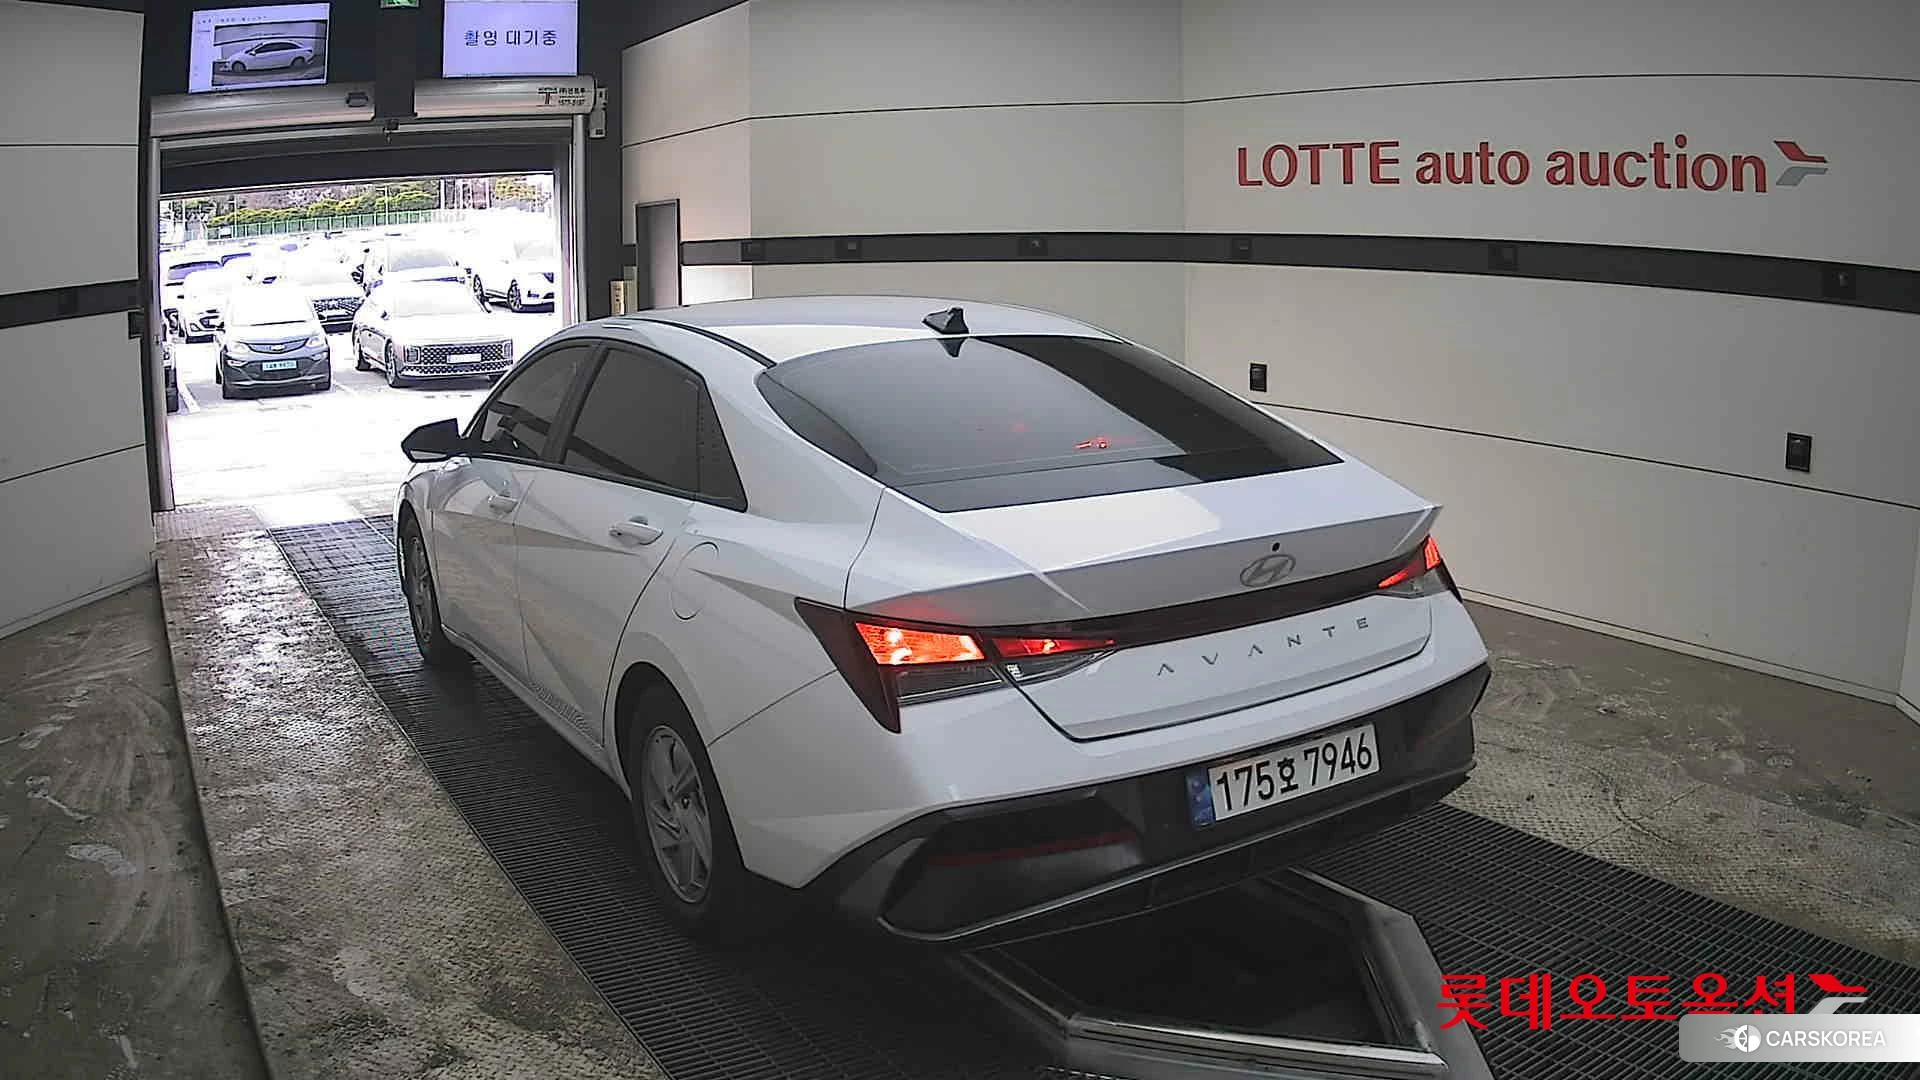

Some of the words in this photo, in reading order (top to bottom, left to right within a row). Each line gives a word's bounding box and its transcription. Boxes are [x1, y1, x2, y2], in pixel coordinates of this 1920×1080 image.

[505, 29, 558, 47] 대기중
[1237, 140, 1400, 187] LOTTE
[1415, 141, 1530, 186] auto
[1544, 133, 1768, 193] auction
[1157, 617, 1369, 676] AVANTE
[1303, 732, 1372, 787] 7946
